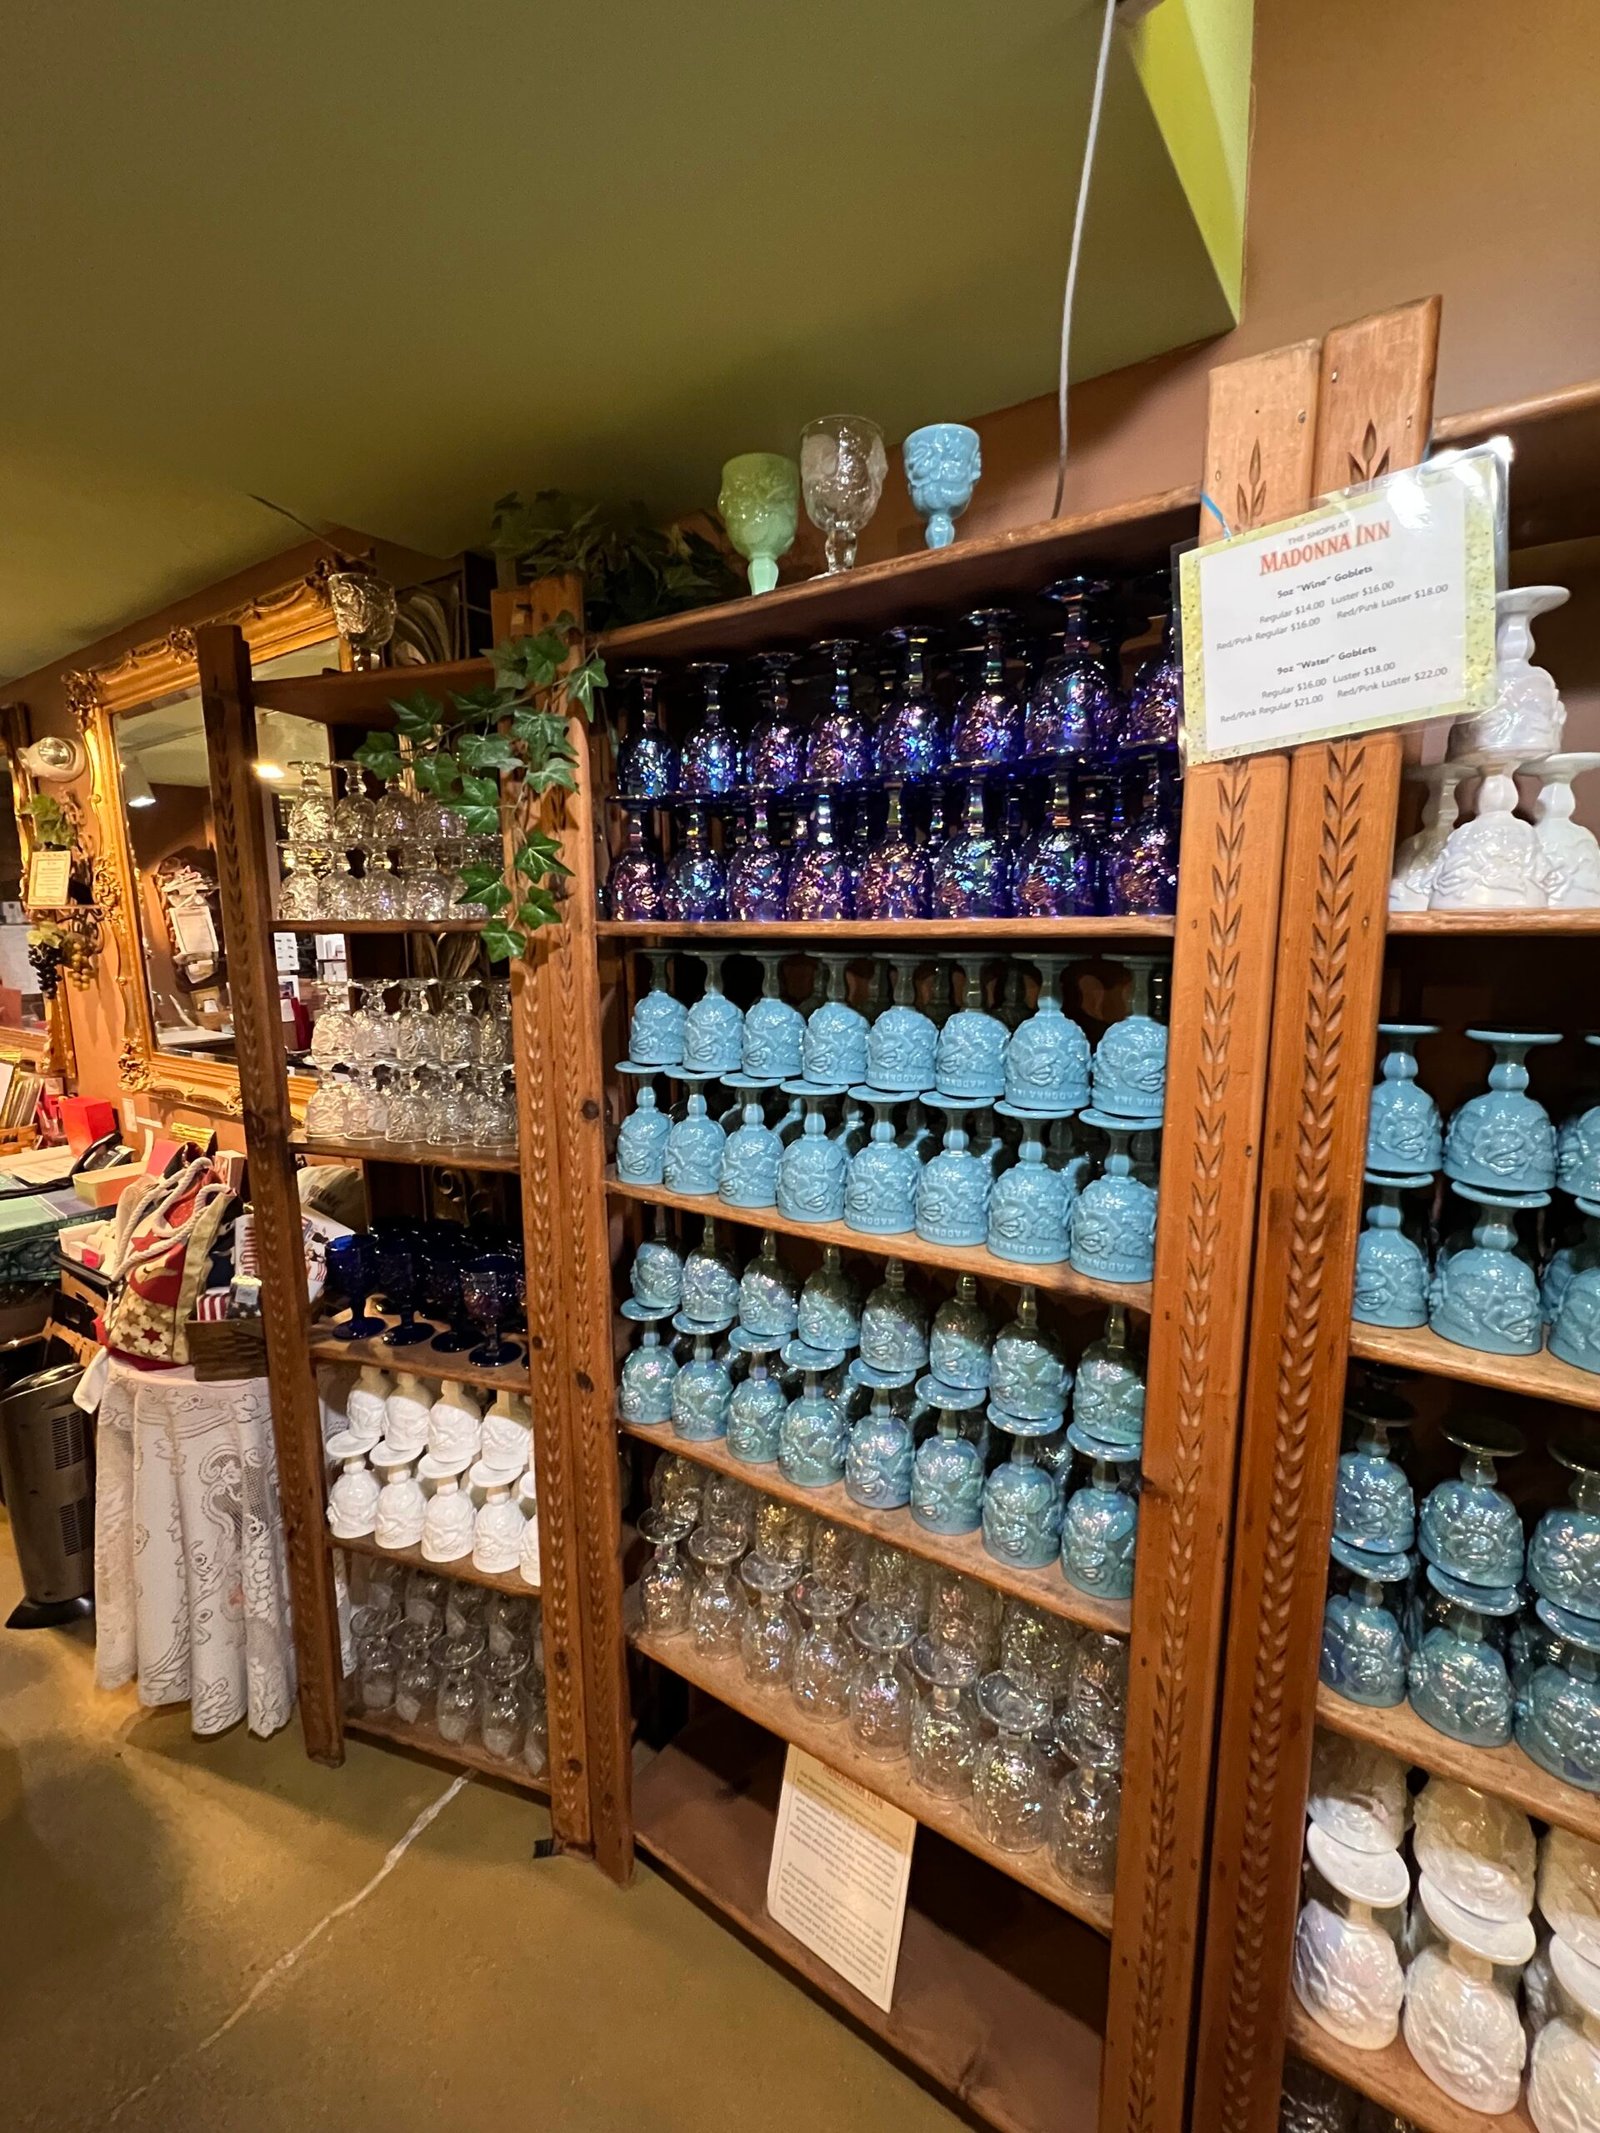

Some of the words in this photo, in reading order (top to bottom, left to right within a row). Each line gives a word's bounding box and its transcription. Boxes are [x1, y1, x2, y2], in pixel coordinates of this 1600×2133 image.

[1259, 532, 1351, 575] MADONNA
[1356, 521, 1391, 547] INN
[1288, 535, 1305, 544] THE
[1307, 523, 1337, 540] SHOPS
[1338, 520, 1350, 530] AT
[1334, 565, 1373, 582] Goblets
[1217, 634, 1253, 651] Red/Pink
[1255, 626, 1288, 641] Regular
[1291, 617, 1320, 632] $16.00
[1337, 602, 1379, 619] Red/Pink
[1381, 593, 1411, 609] Luster
[1415, 584, 1449, 599] $18.00
[1260, 609, 1292, 624] Regular
[1295, 600, 1325, 615] $14.00
[1331, 590, 1359, 605] Luster
[1362, 581, 1394, 596] $16.00
[1338, 645, 1376, 661] Goblets
[1220, 708, 1257, 723] Red/Pink
[1259, 702, 1291, 715] Regular
[1294, 695, 1323, 707] $21.00
[1337, 683, 1379, 698] Red/Pink
[1381, 676, 1411, 688] Luster
[1414, 667, 1448, 681] $22.00
[1262, 686, 1294, 698] Regular
[1297, 678, 1327, 691] $16.00
[1333, 670, 1361, 684] Luster
[1364, 662, 1395, 676] $18.00
